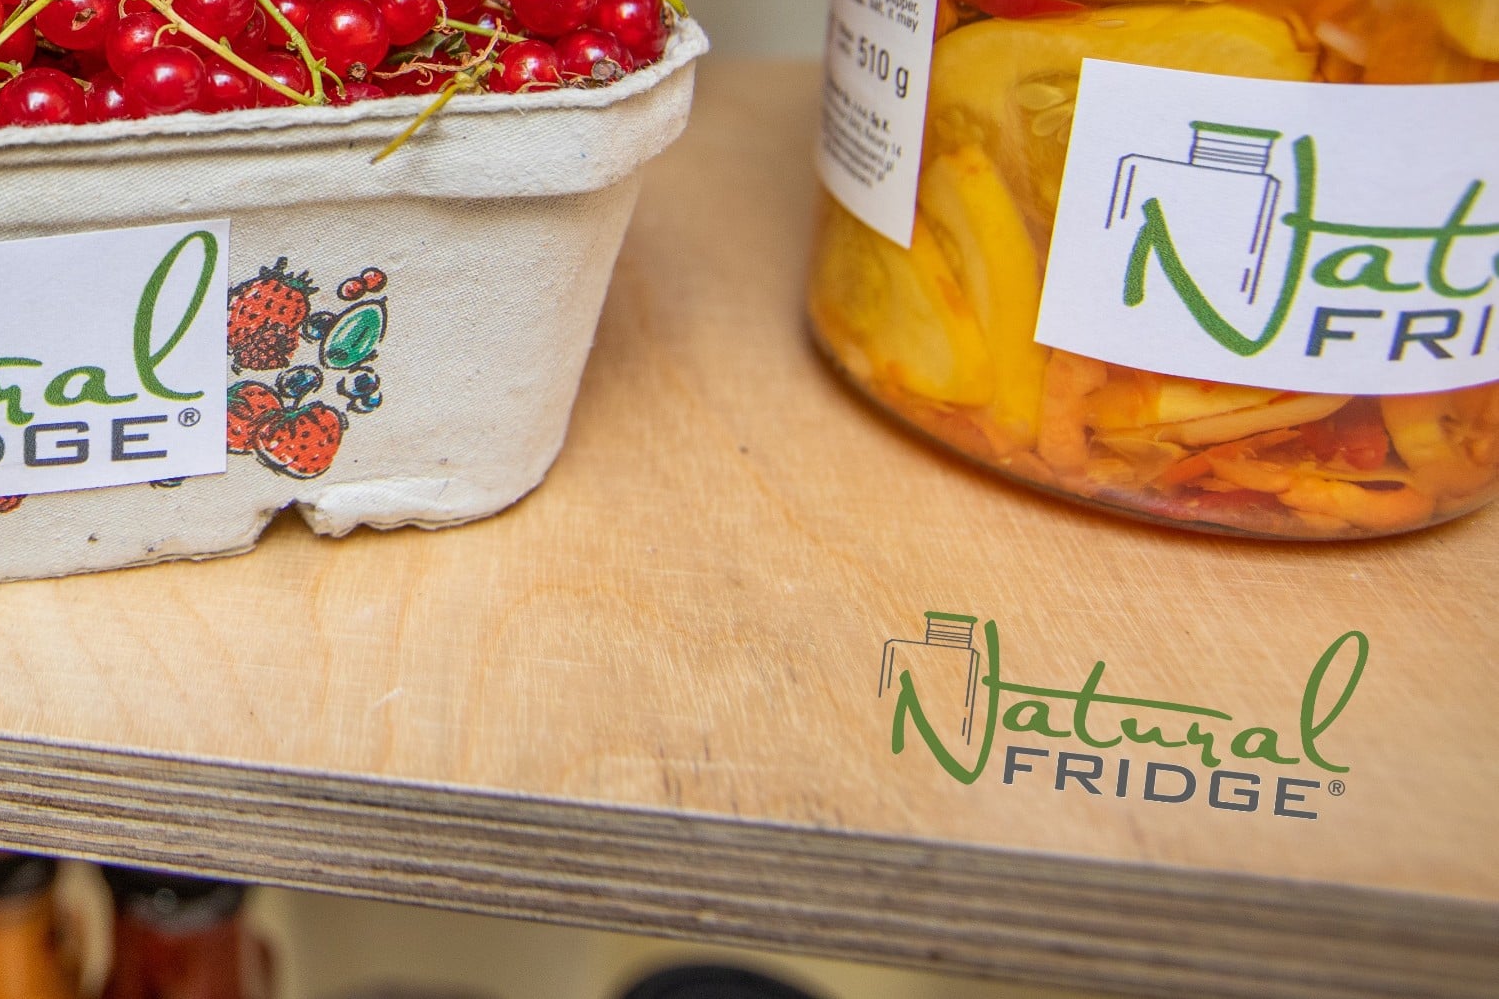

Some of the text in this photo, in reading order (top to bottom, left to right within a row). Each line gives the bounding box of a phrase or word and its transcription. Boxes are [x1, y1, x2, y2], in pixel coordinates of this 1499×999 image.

[858, 36, 890, 81] 510
[895, 66, 909, 99] g
[1123, 135, 1499, 357] Nat
